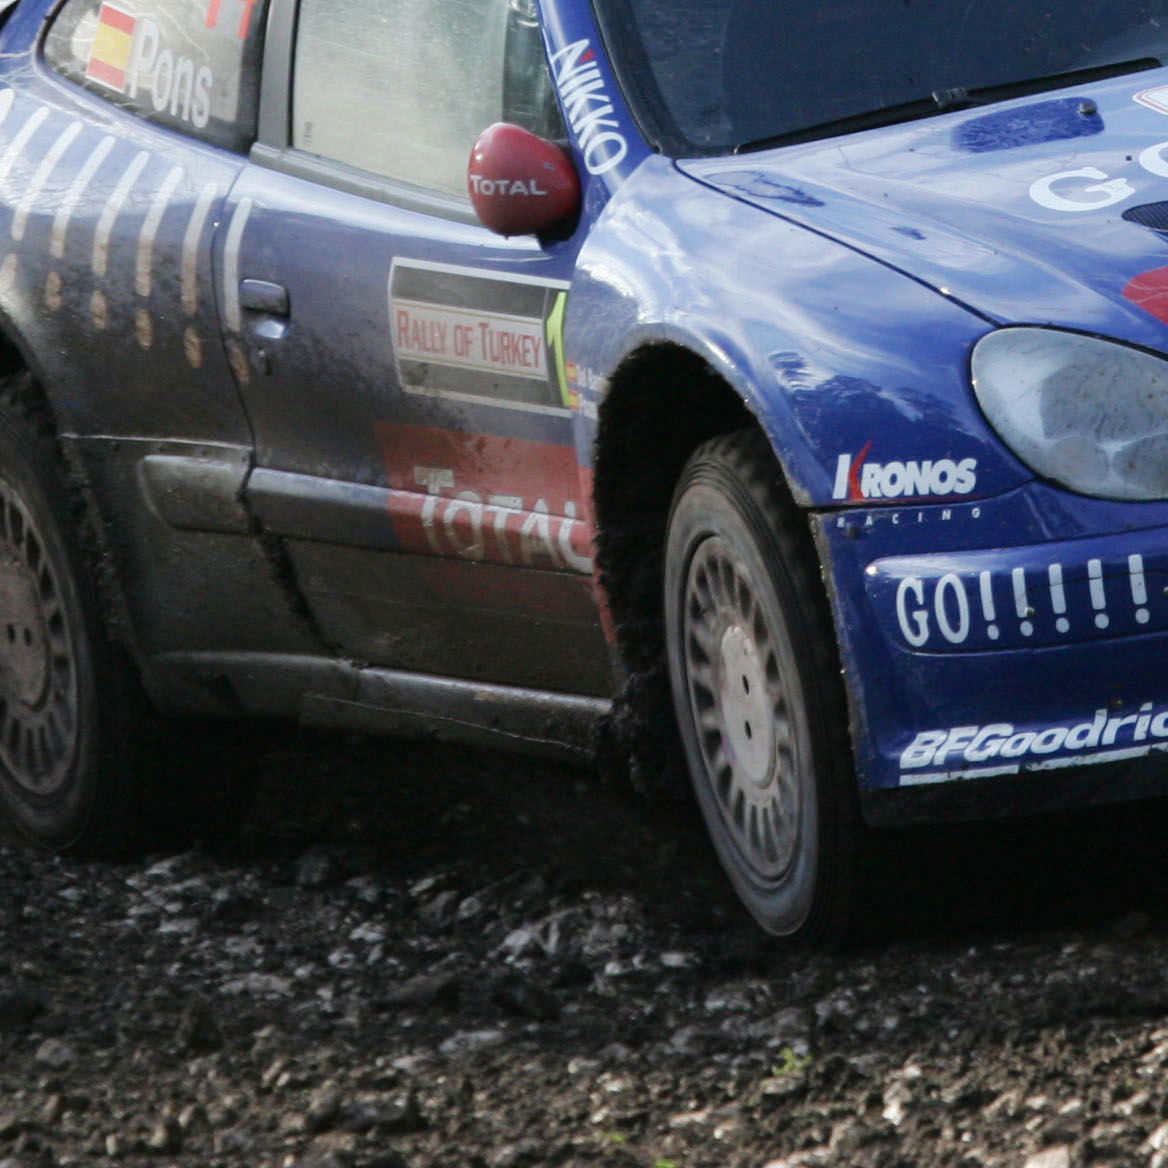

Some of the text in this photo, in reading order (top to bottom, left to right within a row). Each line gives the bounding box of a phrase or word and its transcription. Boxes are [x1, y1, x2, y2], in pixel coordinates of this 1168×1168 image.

[129, 19, 213, 128] Pons
[549, 38, 628, 176] NIKKO
[470, 174, 548, 197] TOTAL
[396, 309, 542, 370] RALLY OF TURKEY
[832, 439, 978, 501] KRONOS
[412, 465, 593, 574] TOTAL
[836, 507, 982, 528] RACING
